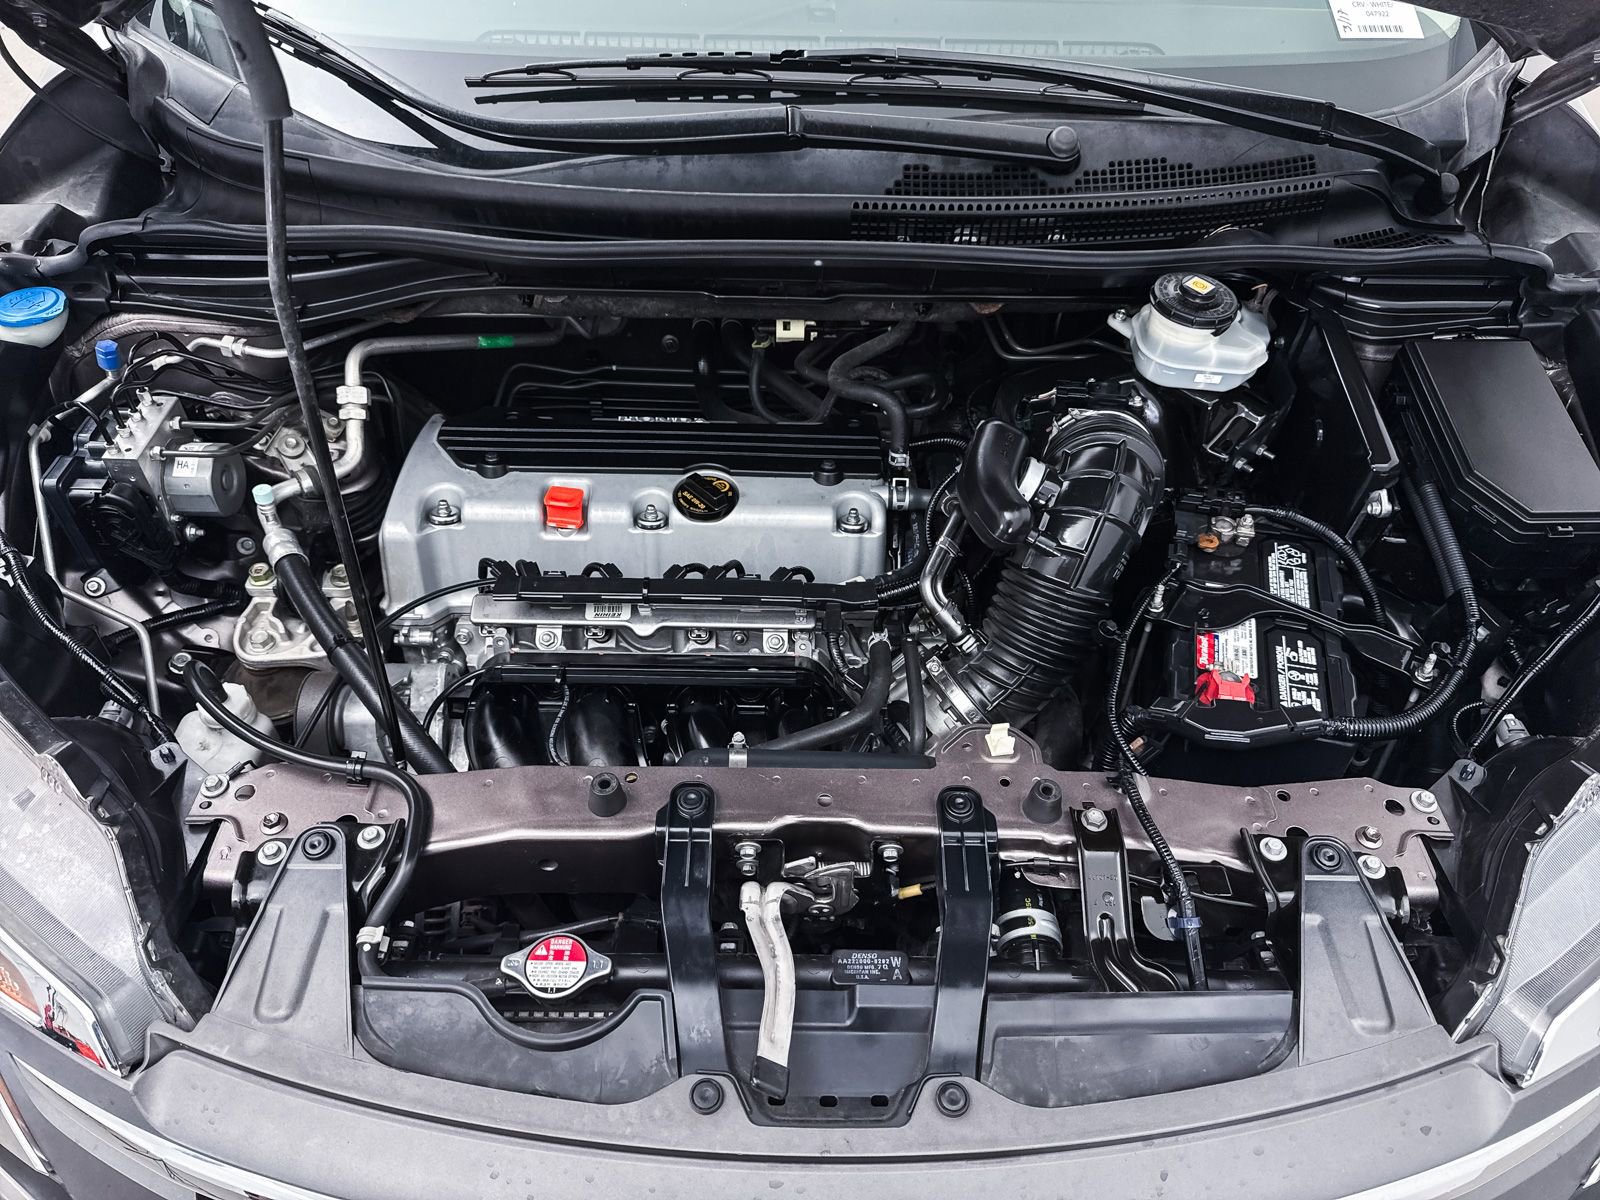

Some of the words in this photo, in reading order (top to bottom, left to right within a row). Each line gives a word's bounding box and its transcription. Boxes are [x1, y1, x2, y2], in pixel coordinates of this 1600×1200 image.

[177, 460, 188, 469] HA
[1275, 645, 1285, 669] POISON
[1278, 673, 1288, 701] DANGER
[890, 957, 901, 967] W
[892, 969, 902, 980] A
